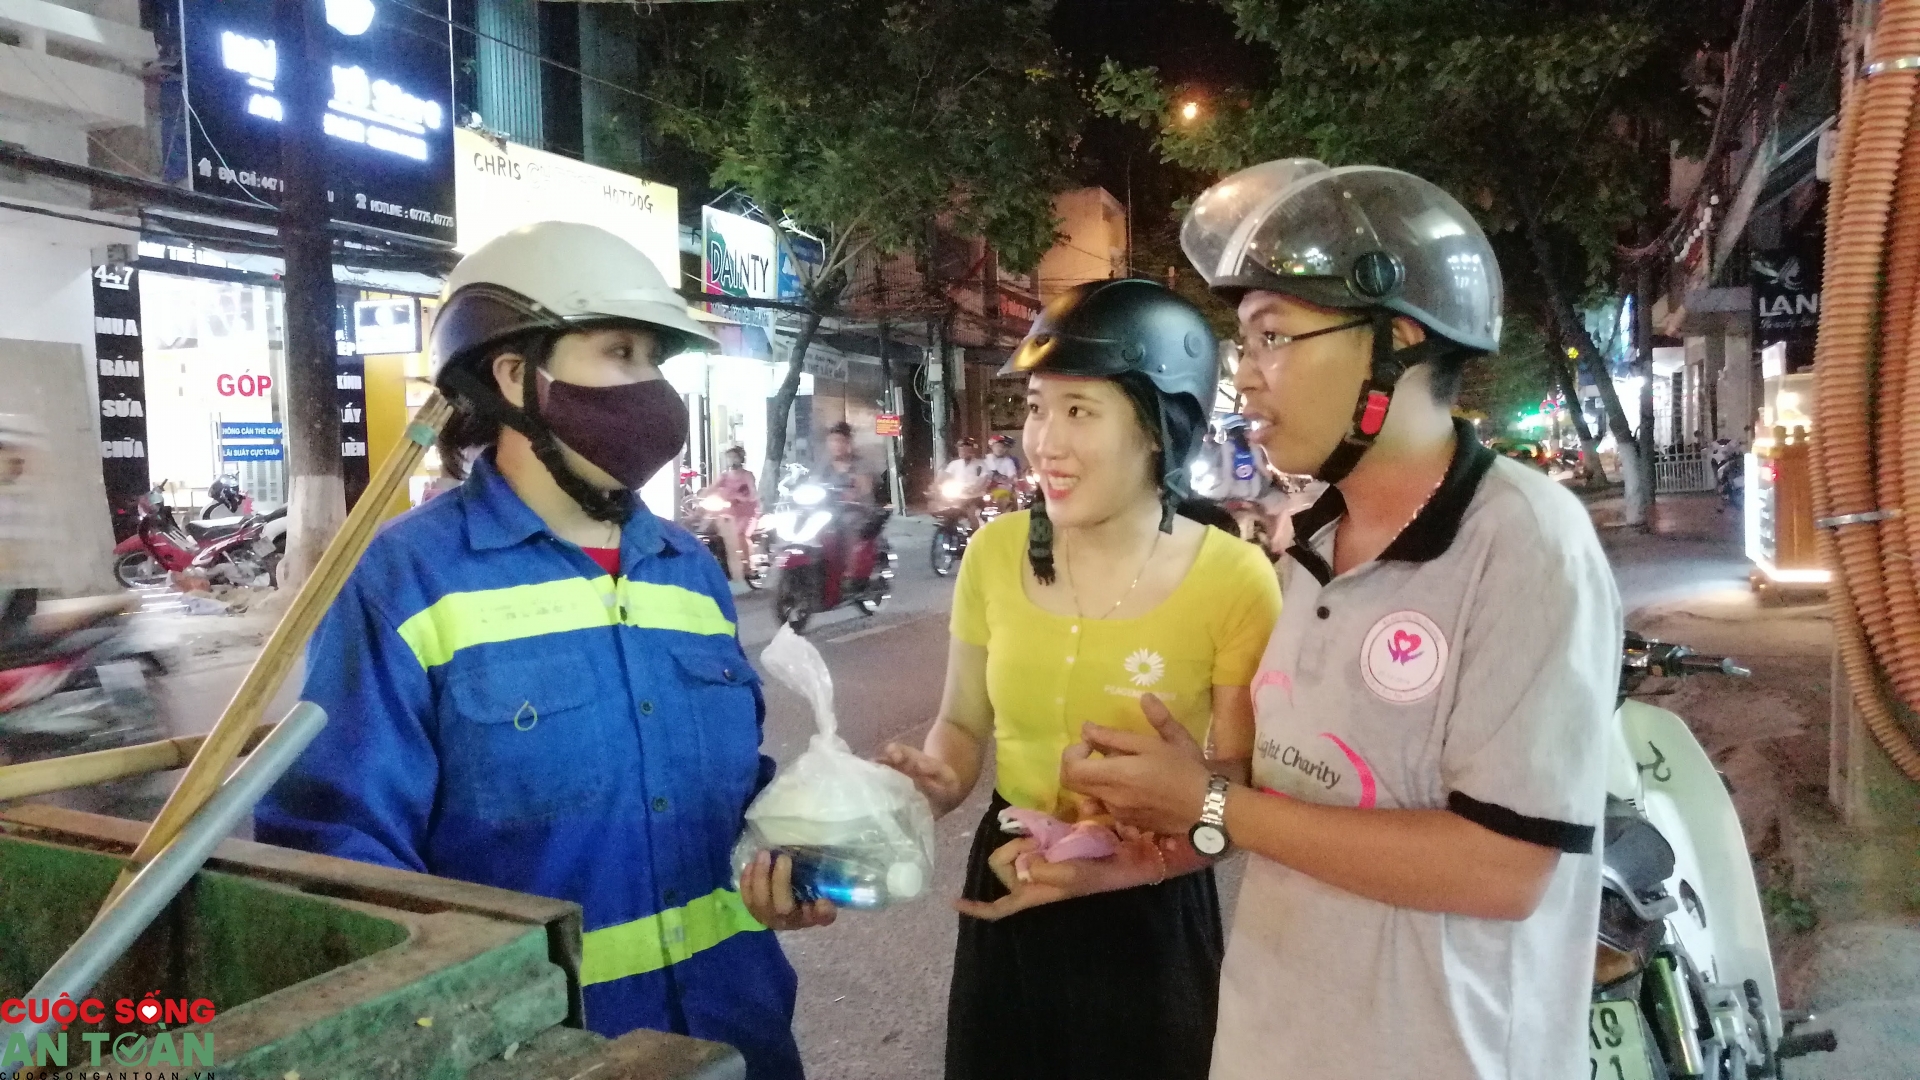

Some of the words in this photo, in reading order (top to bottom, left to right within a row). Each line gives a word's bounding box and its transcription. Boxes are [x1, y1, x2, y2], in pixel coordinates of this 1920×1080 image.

[473, 153, 522, 181] CHRIS
[603, 185, 654, 214] HOTDOG
[94, 264, 134, 286] 447
[710, 240, 769, 293] DAINTY
[95, 317, 139, 336] MUA
[100, 355, 139, 377] BÁN
[217, 368, 272, 397] GÓP
[102, 393, 143, 417] SỬA
[102, 437, 145, 458] CHỮA
[1282, 746, 1341, 790] Charity
